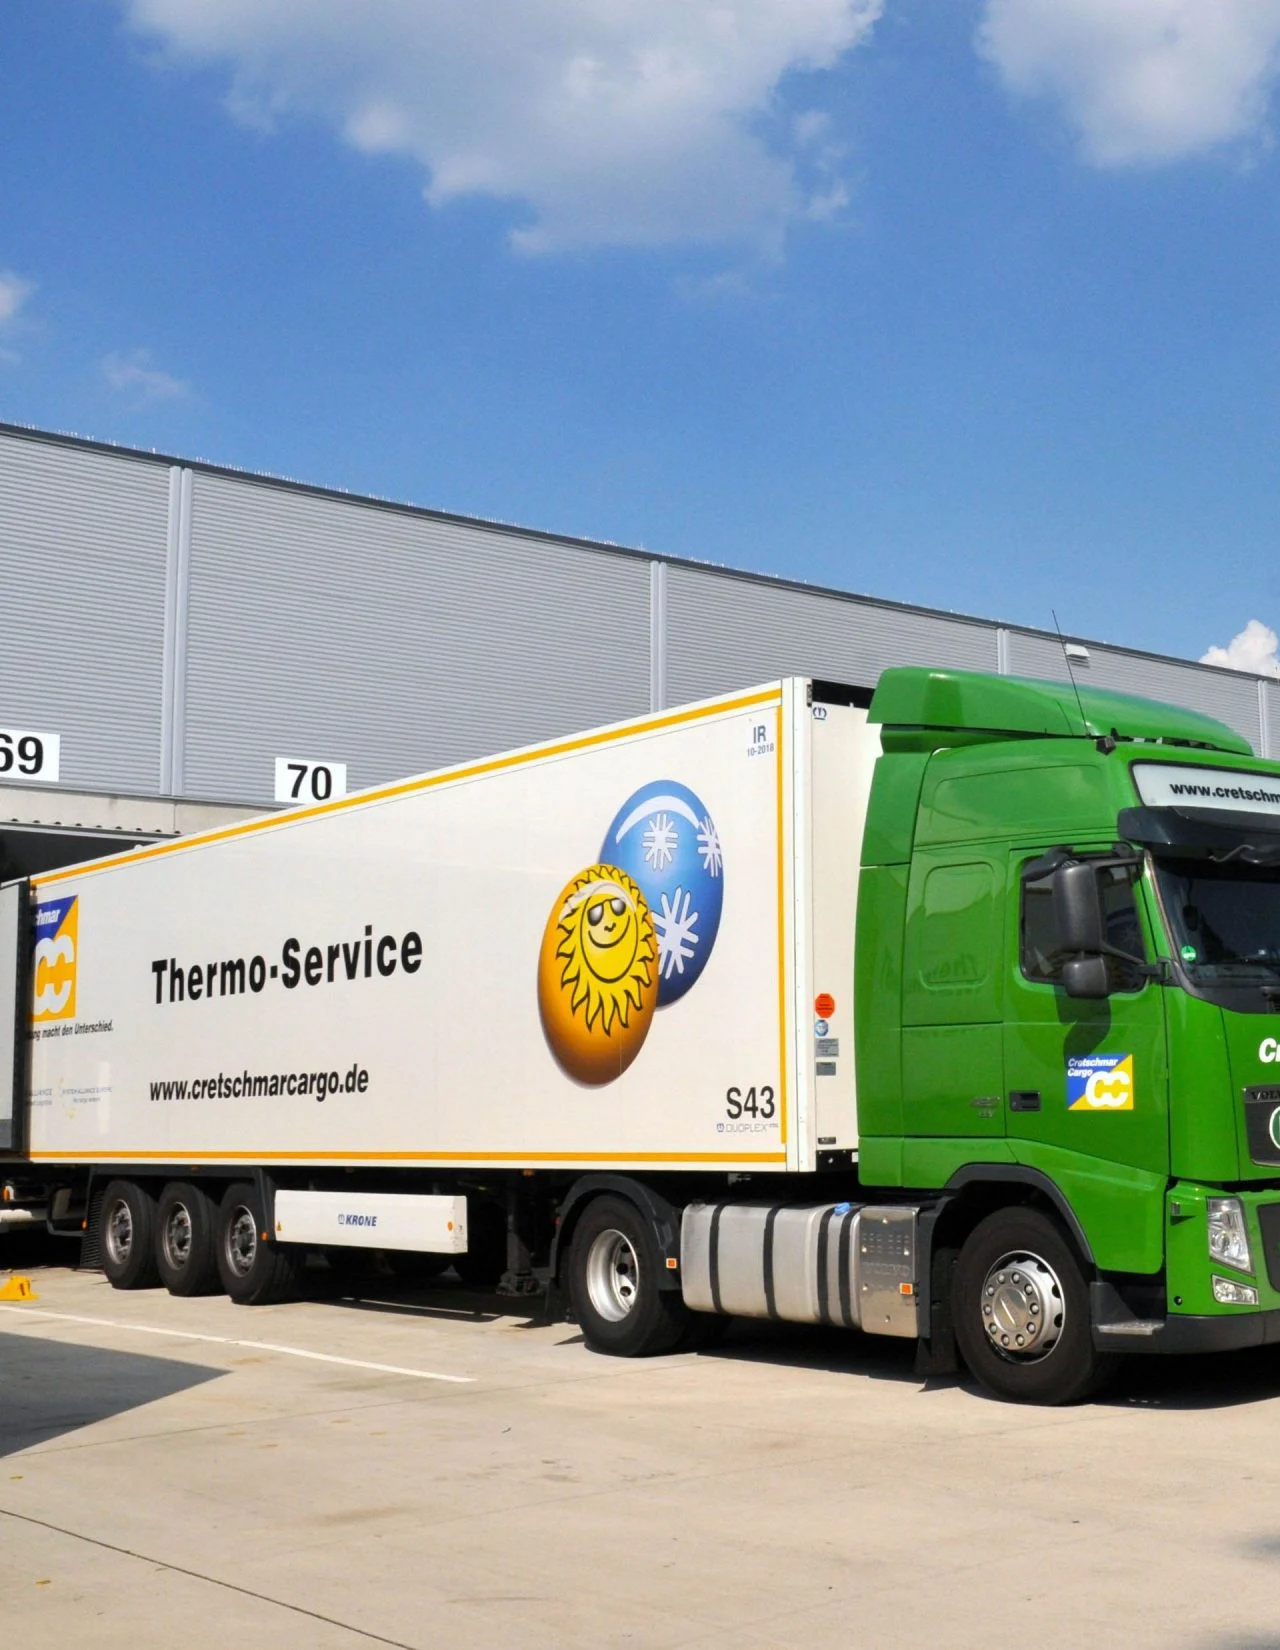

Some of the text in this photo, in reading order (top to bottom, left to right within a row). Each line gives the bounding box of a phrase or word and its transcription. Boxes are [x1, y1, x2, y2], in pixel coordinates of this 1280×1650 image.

[753, 725, 766, 744] IR
[287, 763, 332, 800] 70
[151, 924, 423, 1004] Thermo-Service
[41, 1023, 61, 1038] macht
[61, 1021, 73, 1036] den
[74, 1018, 114, 1035] Unterschied.
[1068, 1057, 1118, 1067] Cretschmar
[1067, 1067, 1093, 1078] Cargo
[150, 1063, 369, 1103] www.cretschmarcargo.de
[726, 1086, 775, 1120] S43
[345, 1213, 377, 1227] KRONE
